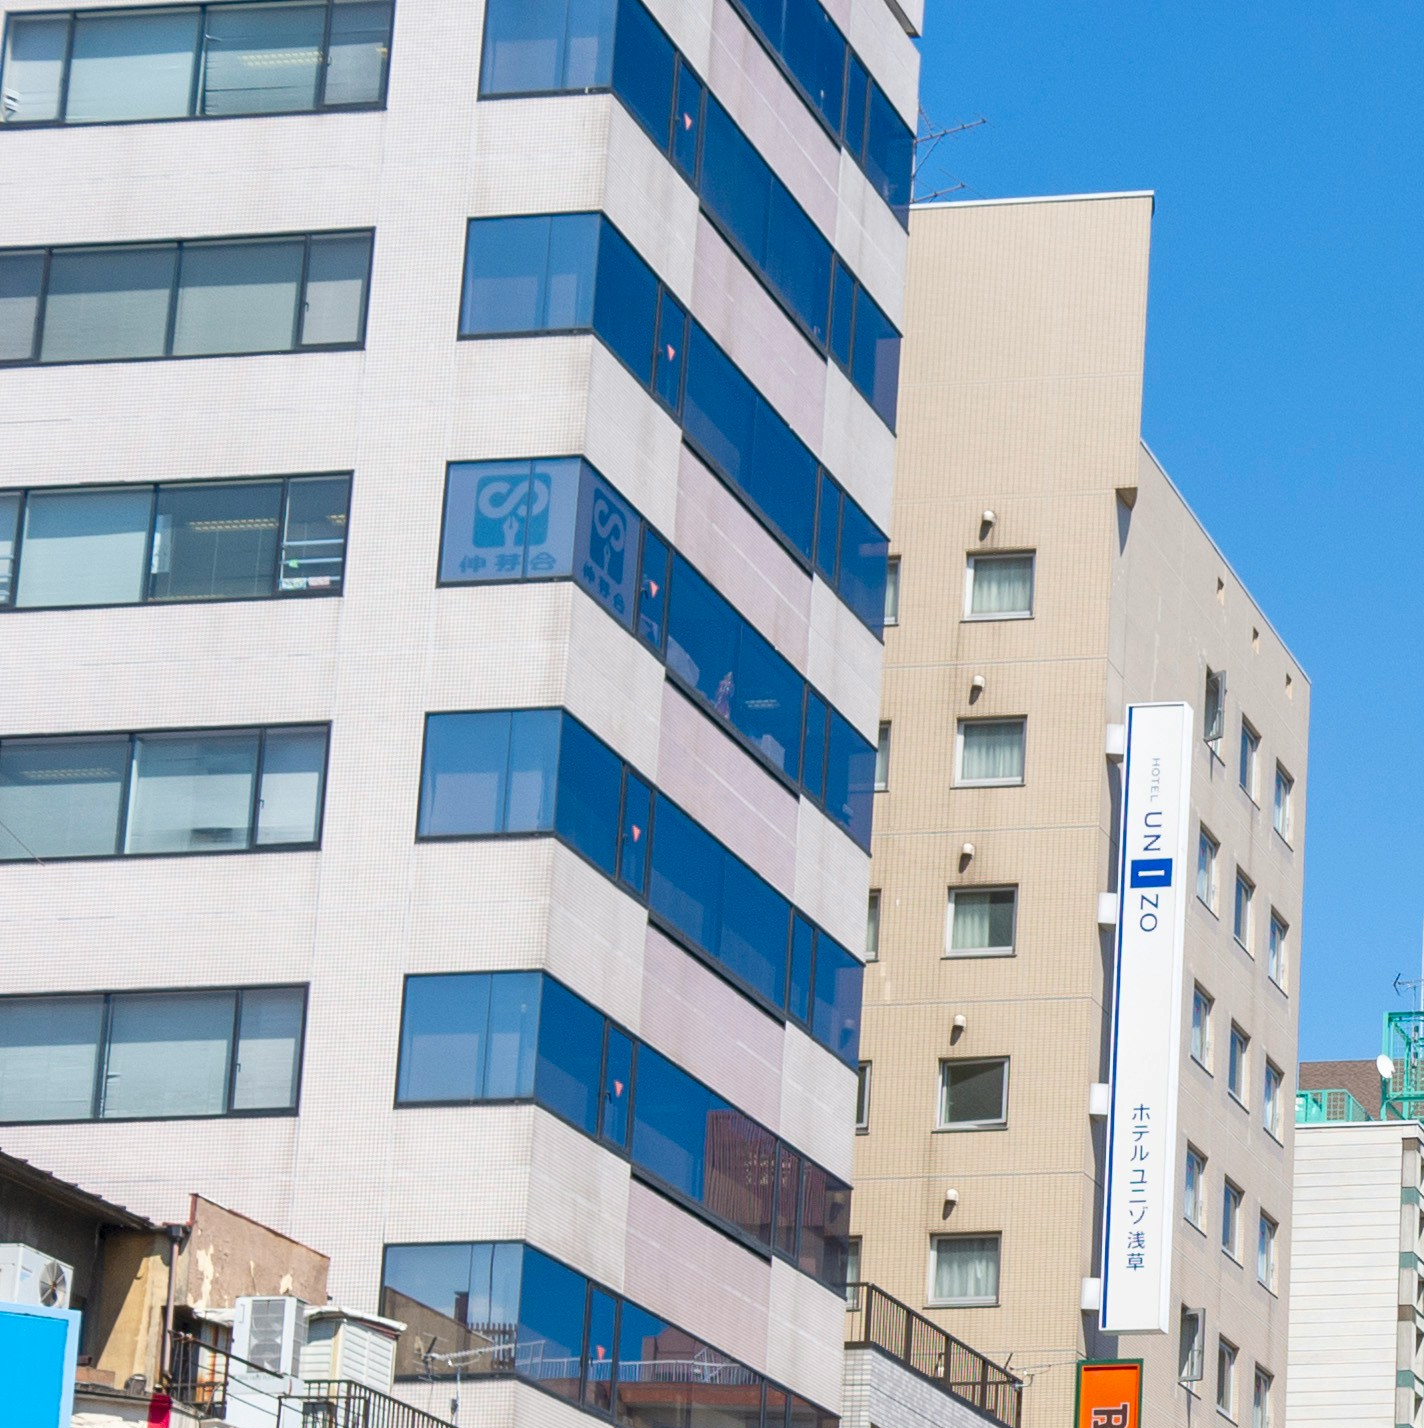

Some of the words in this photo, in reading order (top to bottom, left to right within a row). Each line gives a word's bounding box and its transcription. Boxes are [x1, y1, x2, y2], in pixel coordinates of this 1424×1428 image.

[1151, 758, 1160, 803] HOTEL
[1139, 811, 1164, 933] UNIZO
[1126, 1103, 1151, 1271] ホテルユニゾ浅草
